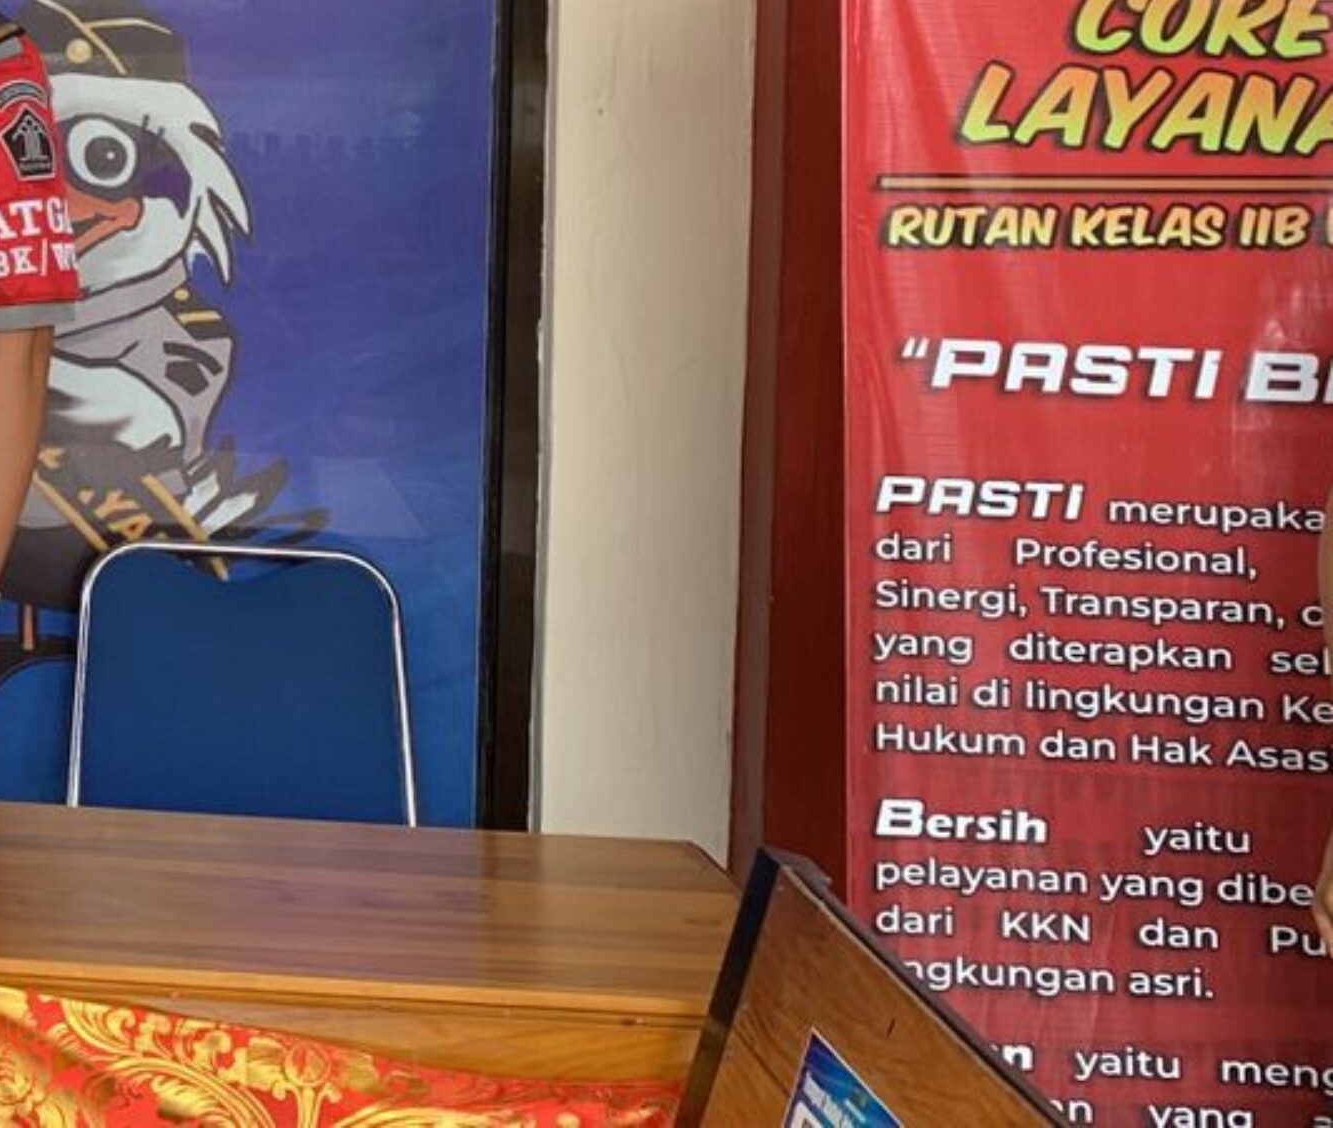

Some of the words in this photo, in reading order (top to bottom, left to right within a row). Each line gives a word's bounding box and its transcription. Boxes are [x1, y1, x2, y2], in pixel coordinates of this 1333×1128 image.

[886, 204, 1058, 249] RUTAN
[1070, 206, 1222, 250] KELAS
[1238, 209, 1310, 250] IIB
[1245, 351, 1333, 407] B
[877, 477, 1083, 519] PASTI
[877, 531, 952, 564] dari
[1015, 538, 1257, 580] Profesional,
[876, 581, 1029, 618] Sinergi,
[1039, 586, 1286, 628] Transparan,
[873, 632, 973, 665] yang
[1009, 632, 1235, 674] diterapkan
[877, 674, 959, 707] nilai
[974, 679, 1011, 709] di
[1025, 681, 1264, 723] lingkungan
[878, 723, 1024, 756] Hukum
[1040, 730, 1115, 759] dan
[1132, 735, 1211, 766] Hak
[877, 799, 1046, 844] Bersih
[1145, 822, 1252, 855] yaitu
[878, 858, 1087, 895] pelayanan
[1101, 874, 1205, 907] yang
[876, 904, 954, 936] dari
[1003, 912, 1089, 940] KKN
[1140, 918, 1218, 948] dan
[1130, 968, 1213, 997] asri.
[1076, 1047, 1179, 1080] yaitu
